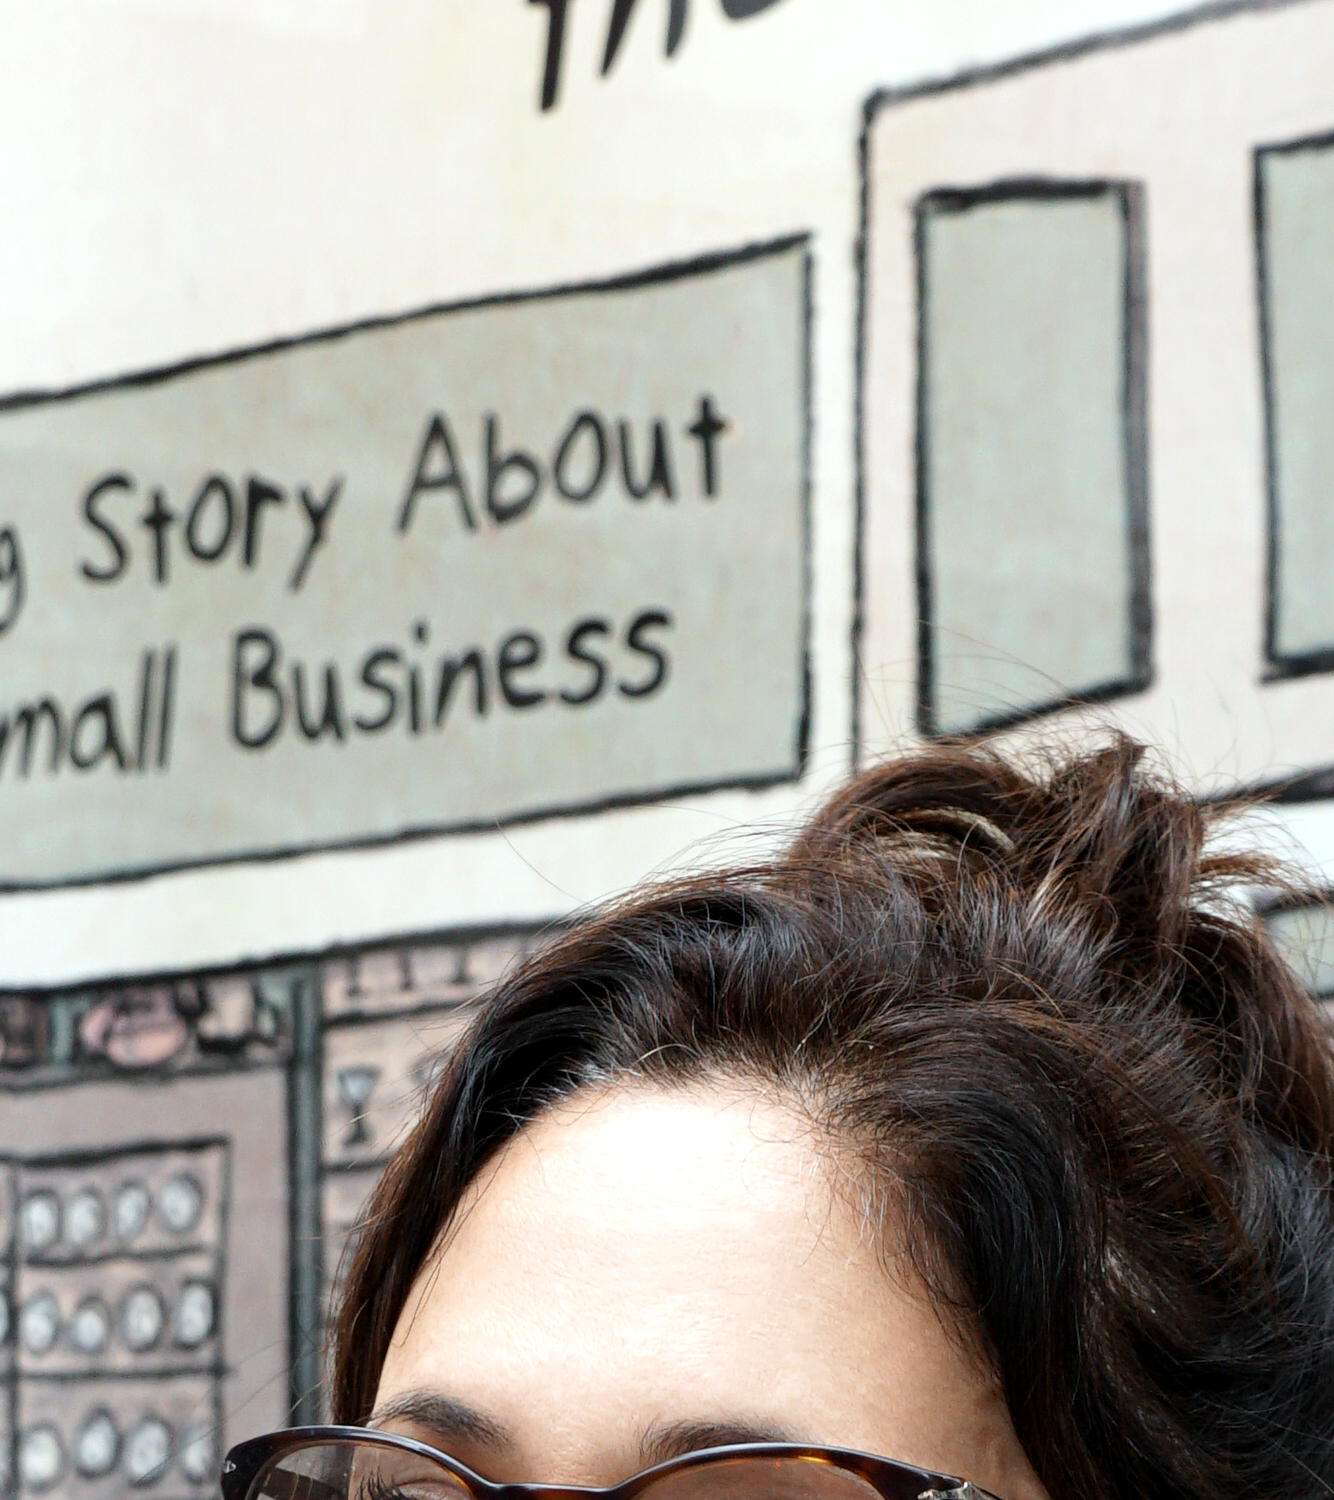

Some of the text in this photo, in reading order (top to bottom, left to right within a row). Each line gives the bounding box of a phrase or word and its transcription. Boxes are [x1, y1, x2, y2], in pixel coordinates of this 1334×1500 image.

[78, 470, 346, 592] Story
[395, 393, 731, 536] About
[228, 606, 675, 752] Business
